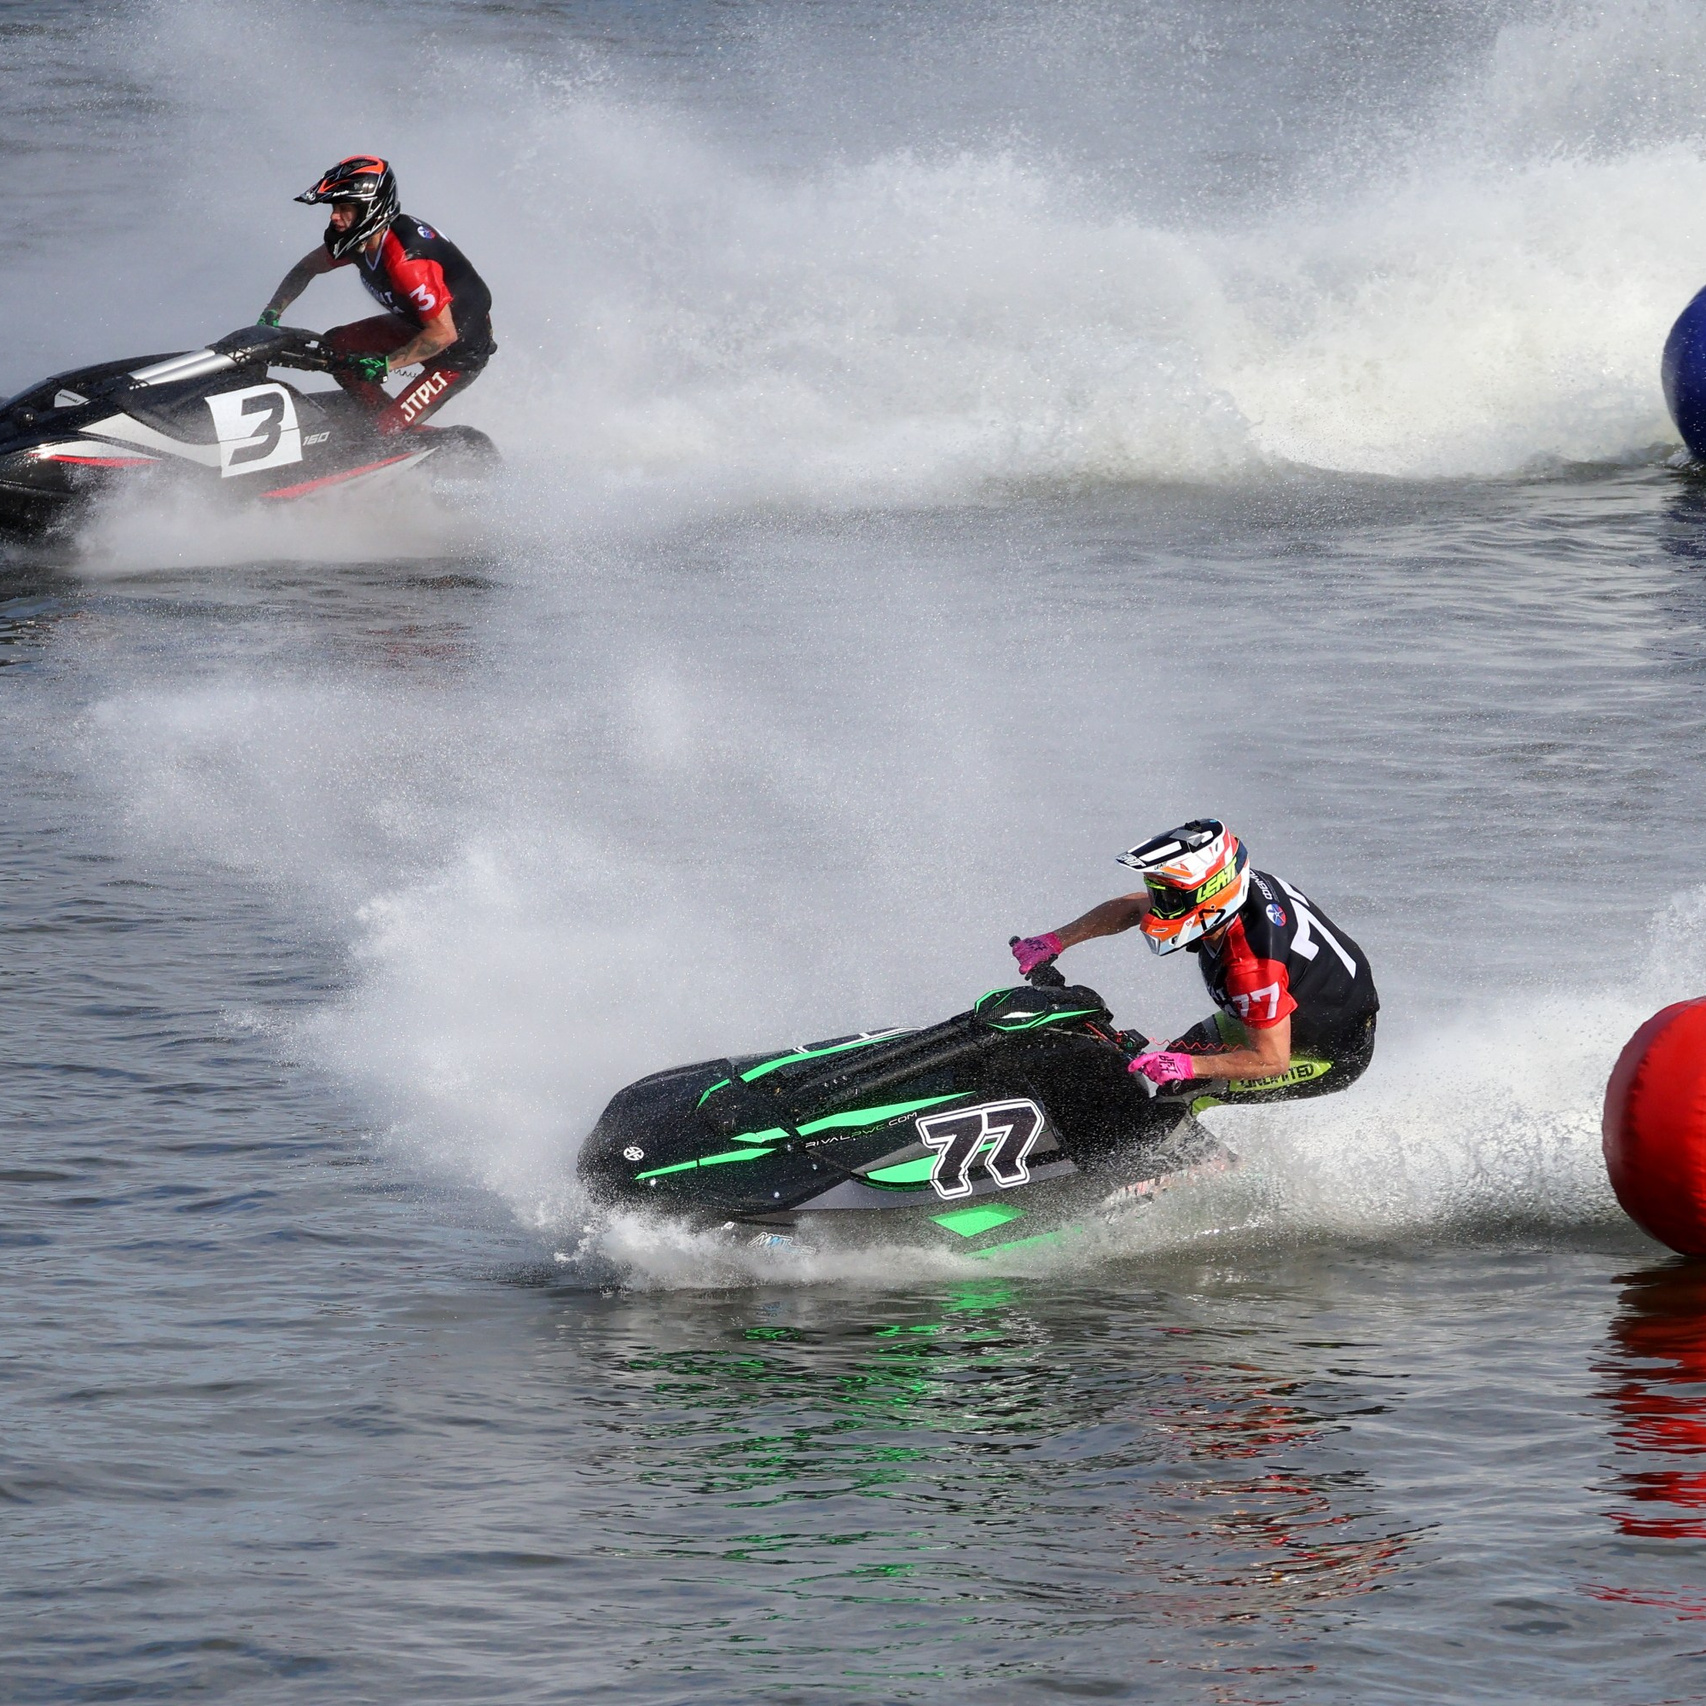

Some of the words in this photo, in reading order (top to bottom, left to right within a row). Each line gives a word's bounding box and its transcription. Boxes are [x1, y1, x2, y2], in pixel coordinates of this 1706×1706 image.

[409, 283, 436, 311] 3
[400, 371, 448, 422] JTPLT
[228, 391, 285, 467] 3
[302, 431, 331, 447] 160
[1195, 857, 1238, 904] LEATT
[1231, 981, 1281, 1019] 77
[915, 1098, 1045, 1200] 77
